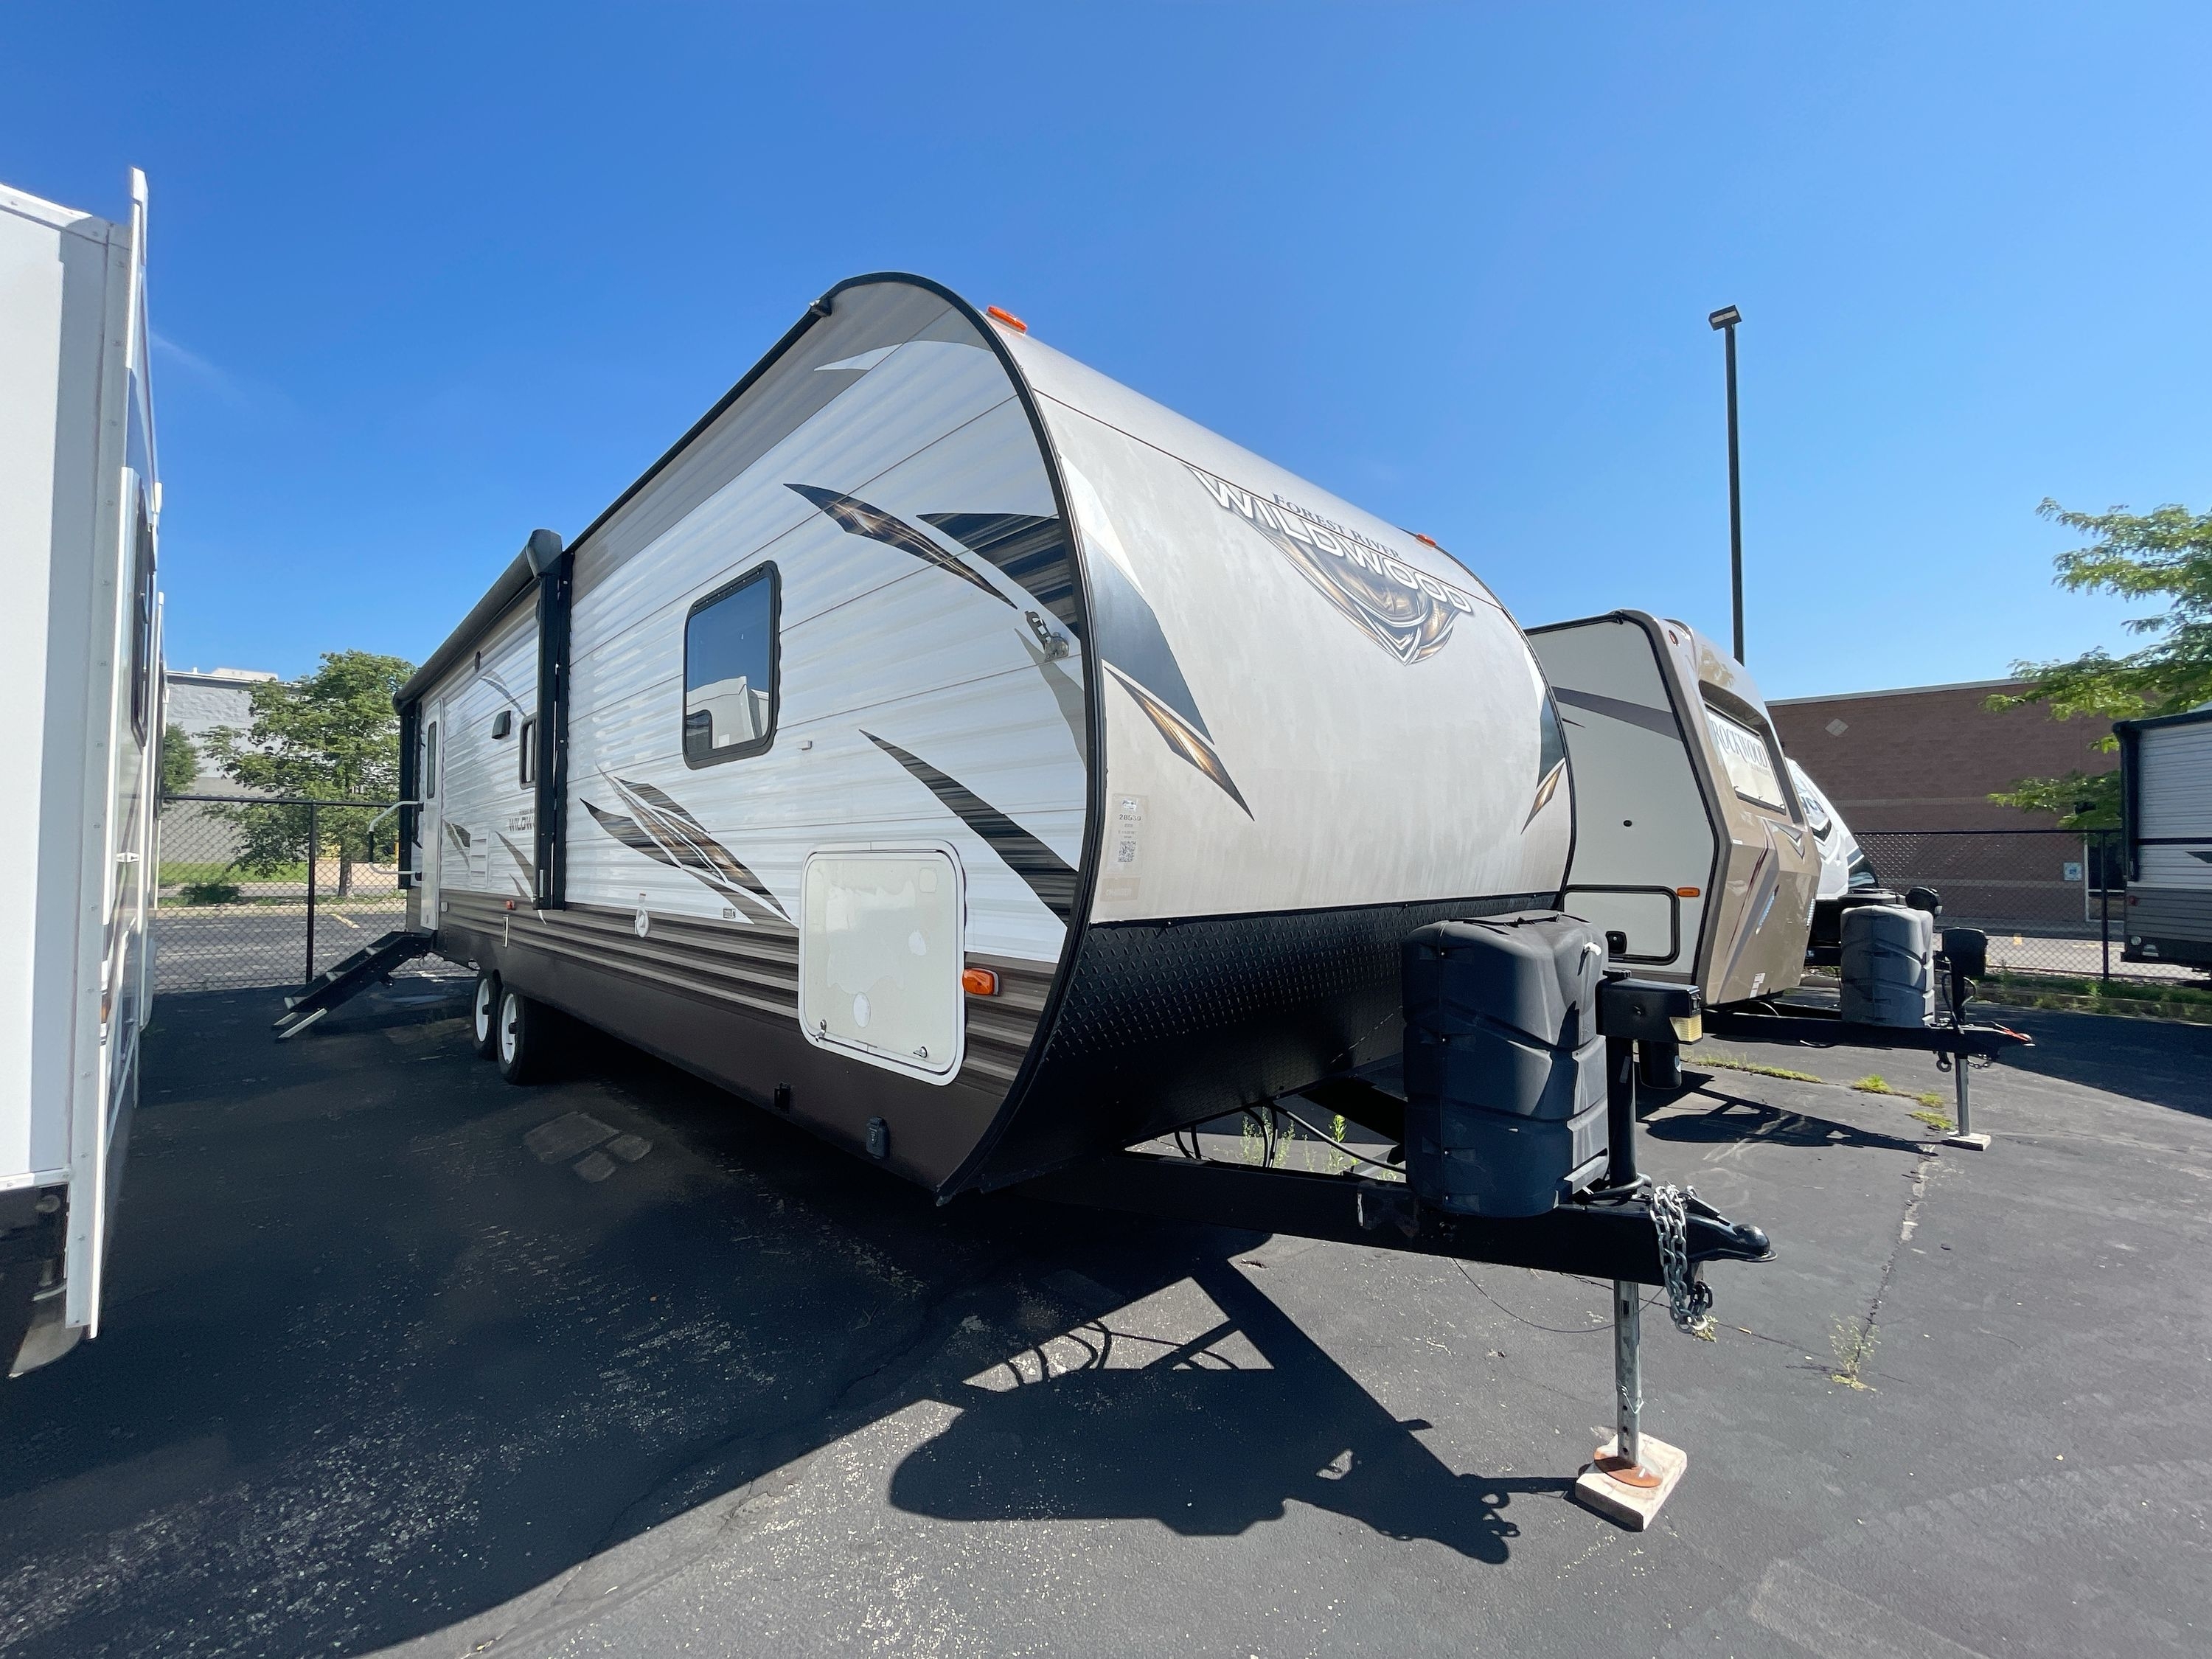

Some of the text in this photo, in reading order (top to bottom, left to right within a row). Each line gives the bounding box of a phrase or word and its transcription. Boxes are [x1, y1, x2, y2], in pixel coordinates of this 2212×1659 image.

[1188, 466, 1473, 613] WILDWOOD
[1273, 493, 1402, 560] FOREST RIVER
[1711, 720, 1768, 768] ROCKWOOD
[509, 815, 535, 832] WILDW
